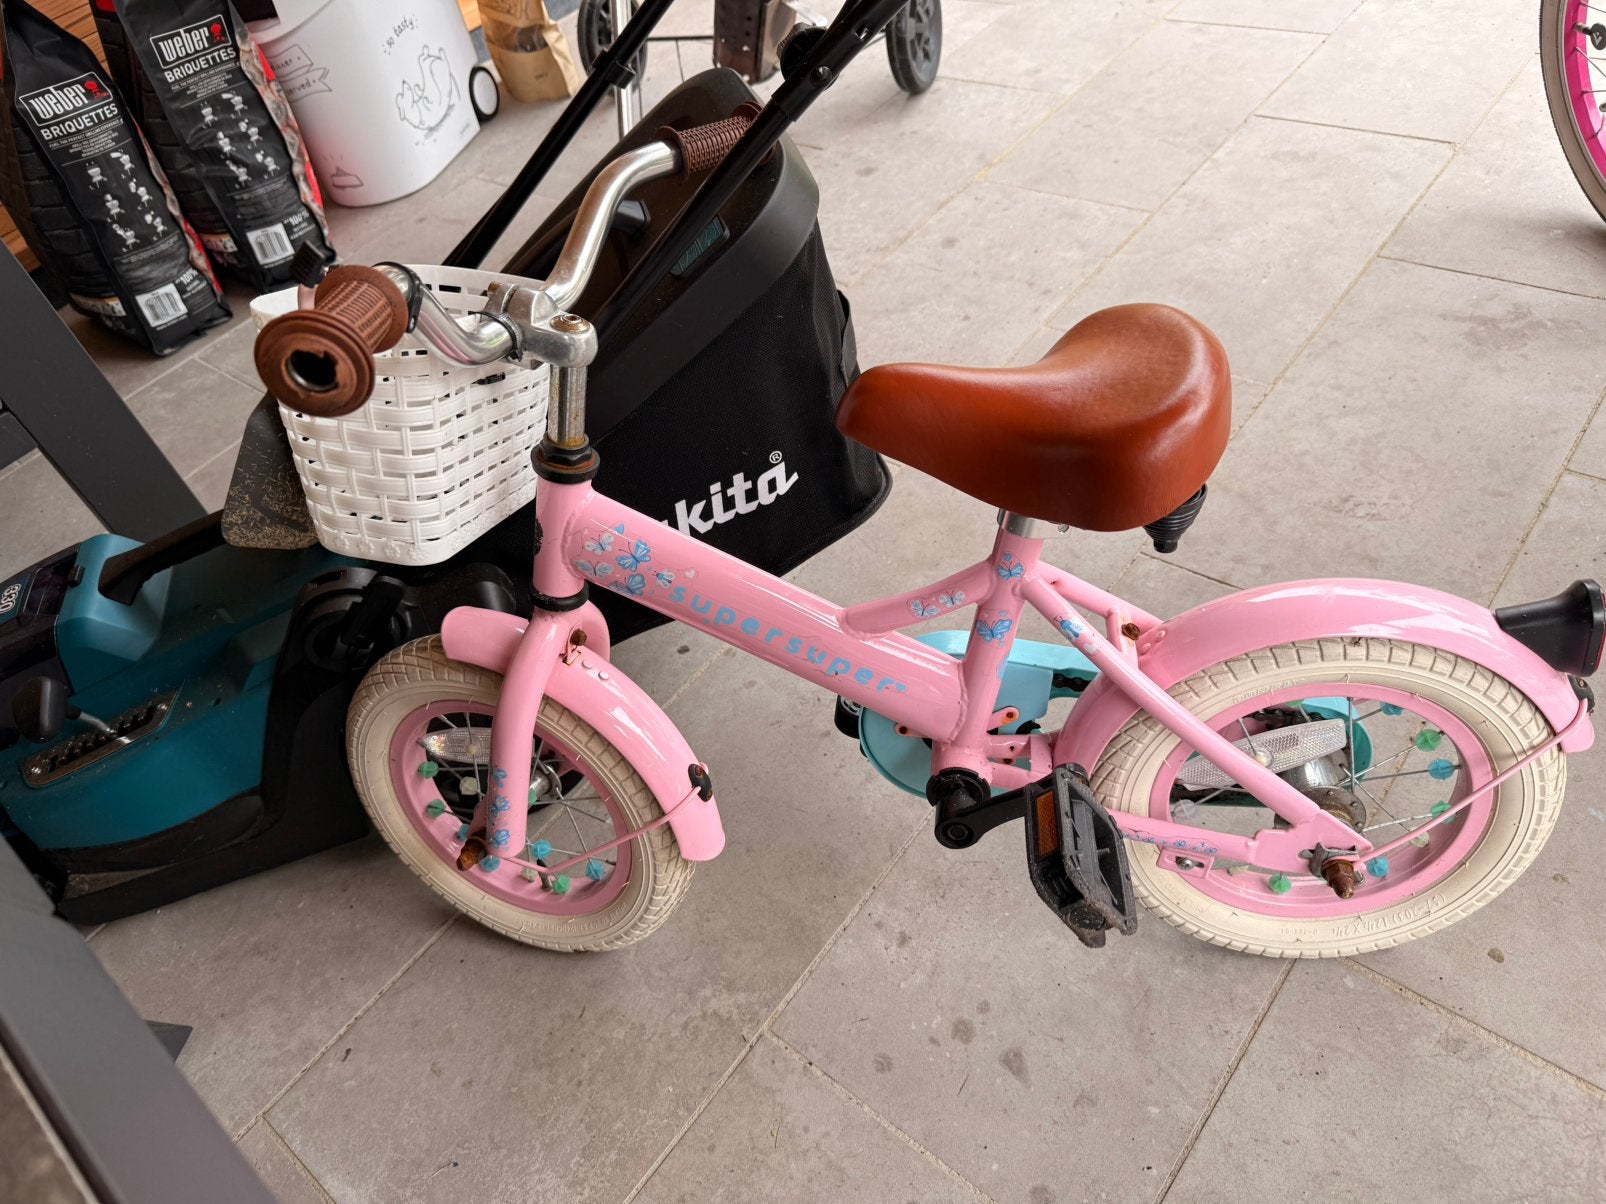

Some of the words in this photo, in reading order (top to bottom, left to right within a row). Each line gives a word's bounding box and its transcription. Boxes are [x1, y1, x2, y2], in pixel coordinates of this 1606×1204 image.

[164, 47, 236, 83] BRIQUETTES
[40, 103, 118, 140] BRIQUETTES
[662, 461, 799, 537] kita
[669, 584, 895, 694] supersuper
